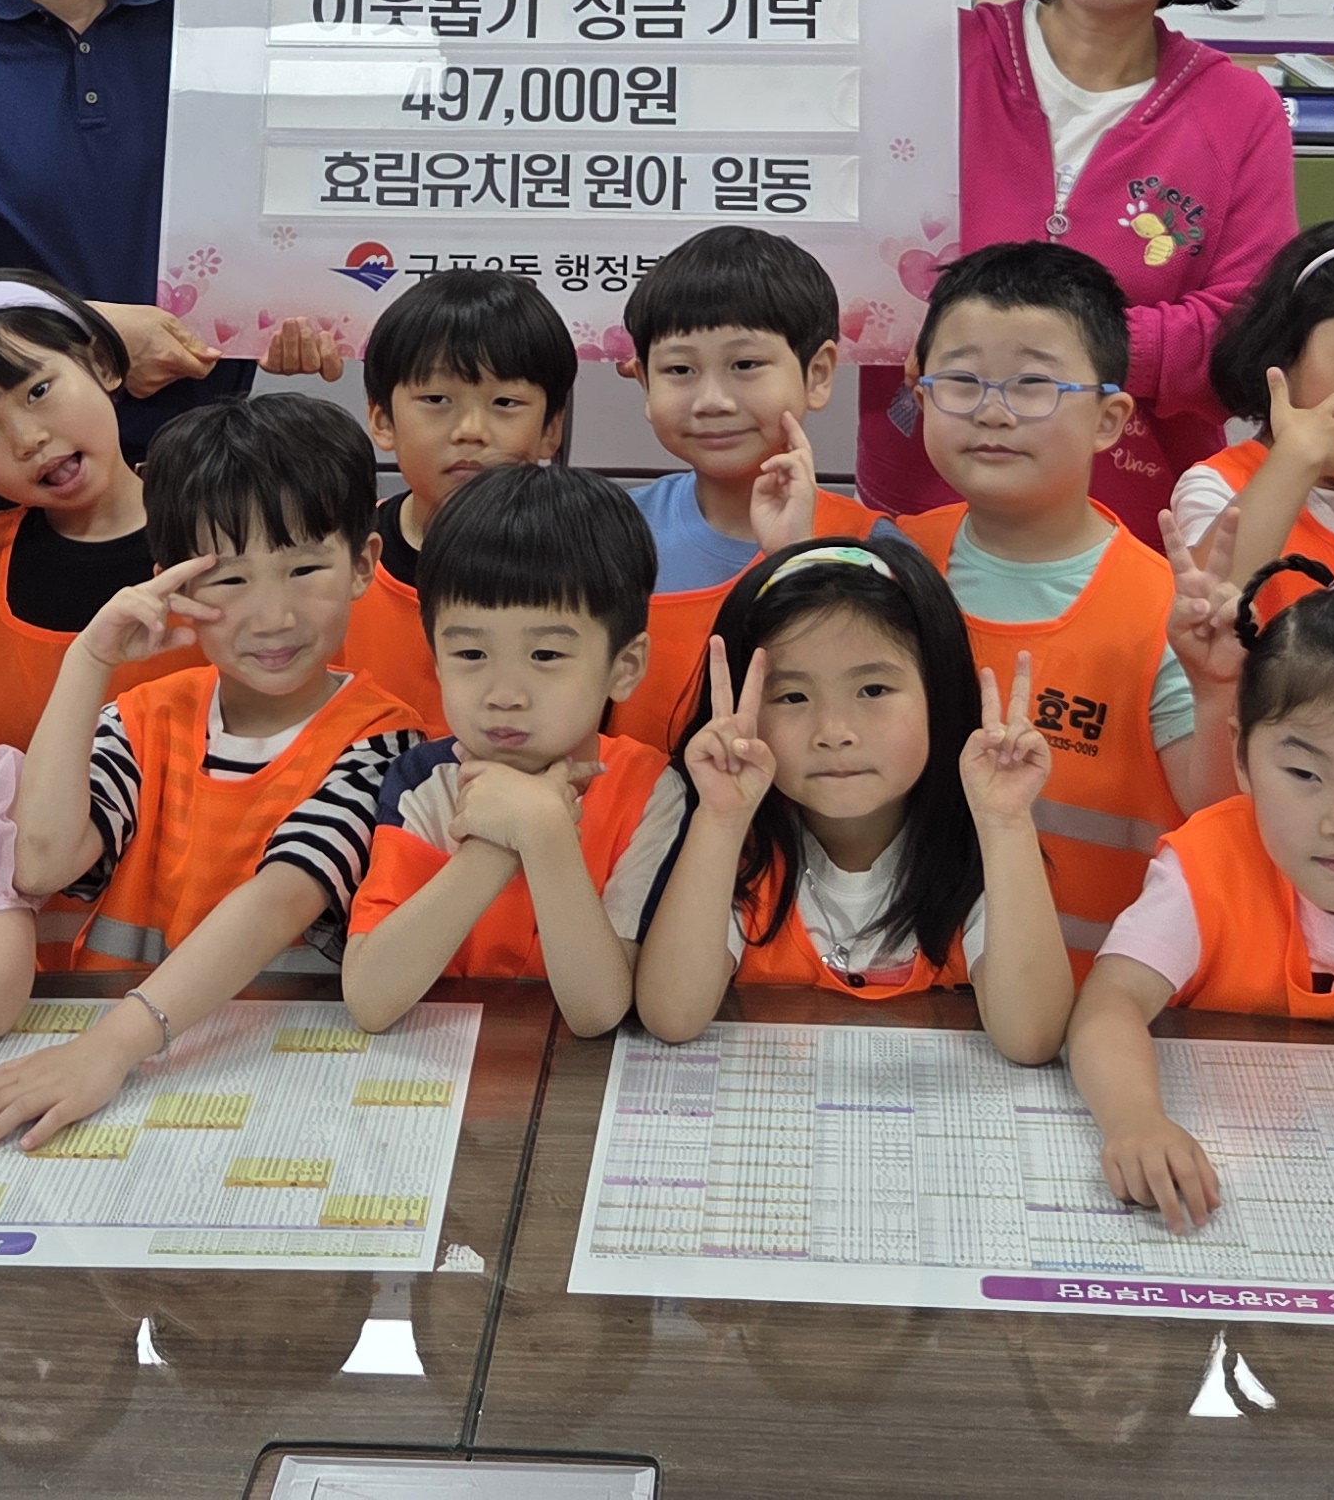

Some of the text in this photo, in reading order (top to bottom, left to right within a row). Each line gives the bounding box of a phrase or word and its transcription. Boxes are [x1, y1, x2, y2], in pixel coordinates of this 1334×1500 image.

[401, 66, 679, 126] 497,000원
[320, 152, 812, 214] 효림유치원 원아 일동
[1034, 687, 1108, 741] 효림
[1058, 1283, 1318, 1309] 간부명단 부산광역시
